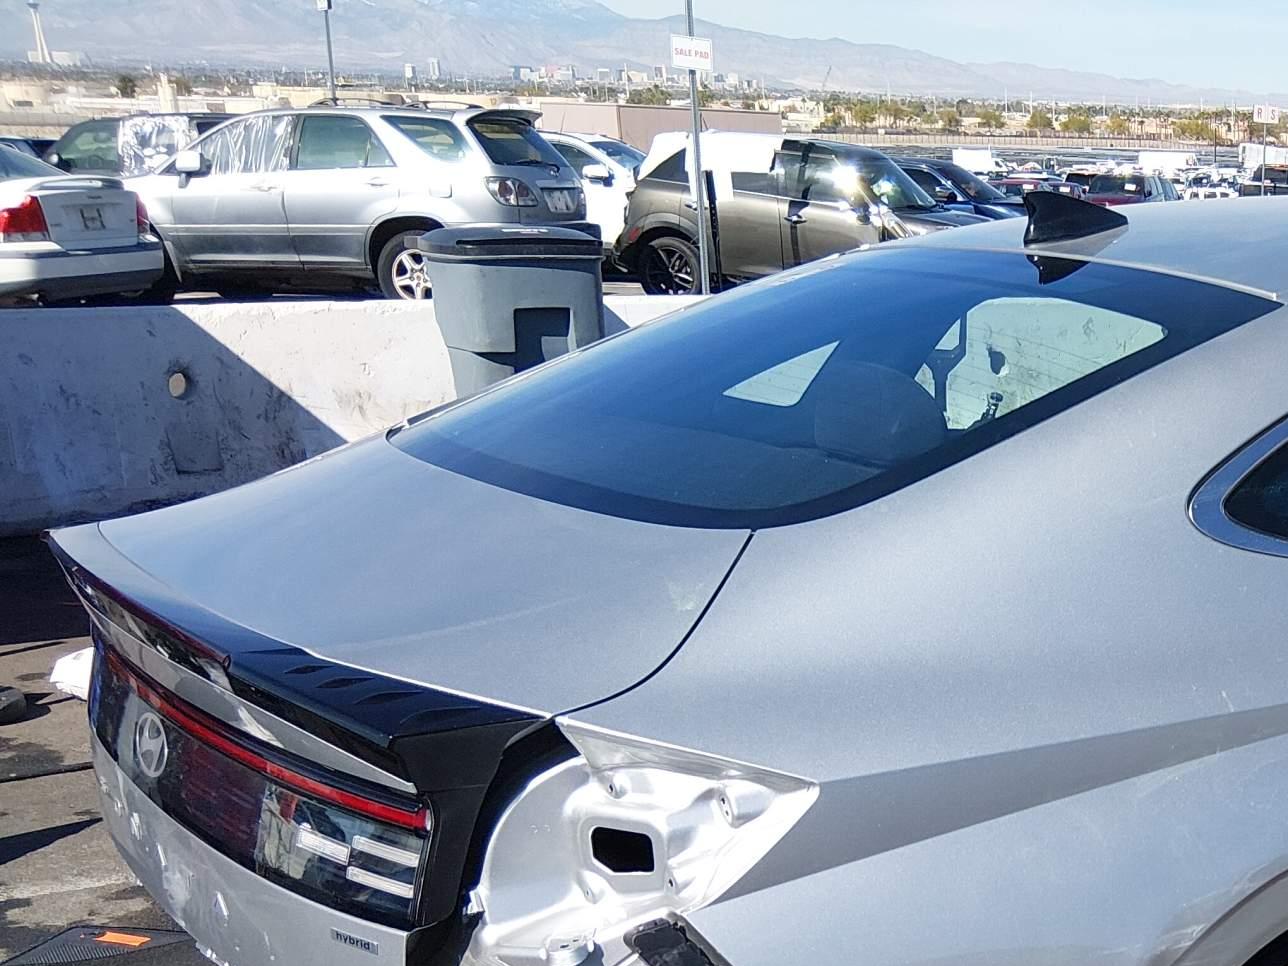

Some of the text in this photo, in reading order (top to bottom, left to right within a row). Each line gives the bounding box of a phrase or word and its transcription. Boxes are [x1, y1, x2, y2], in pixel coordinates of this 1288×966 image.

[674, 47, 710, 60] SALE PAD
[335, 930, 371, 951] hybrid
